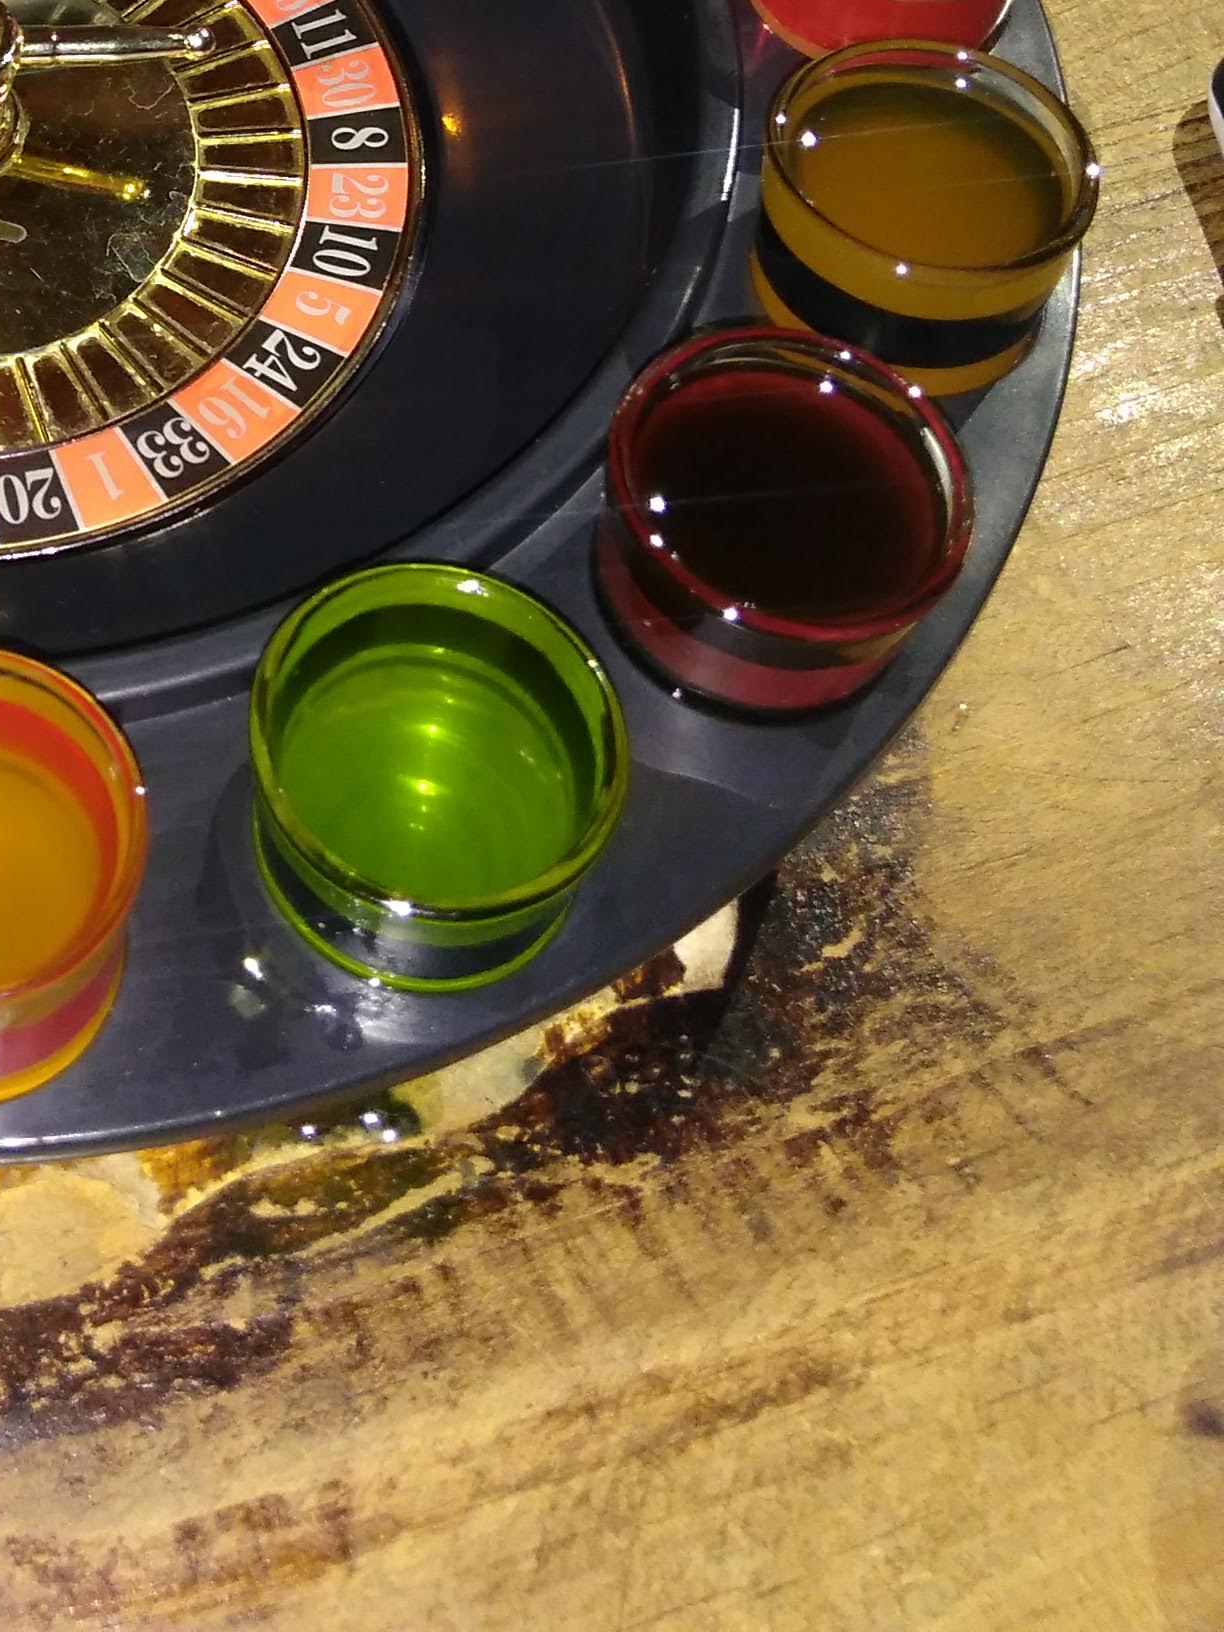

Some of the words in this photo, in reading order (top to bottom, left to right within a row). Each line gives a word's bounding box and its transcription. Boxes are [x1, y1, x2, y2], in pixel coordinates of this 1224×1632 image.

[290, 8, 357, 60] 11
[315, 60, 376, 108] 30
[331, 127, 389, 150] 8
[329, 172, 389, 218] 23
[312, 225, 378, 277] 10
[294, 290, 352, 325] 5
[242, 330, 322, 393] 24
[197, 376, 274, 441] 16
[136, 418, 210, 479] 33
[85, 450, 125, 501] 1
